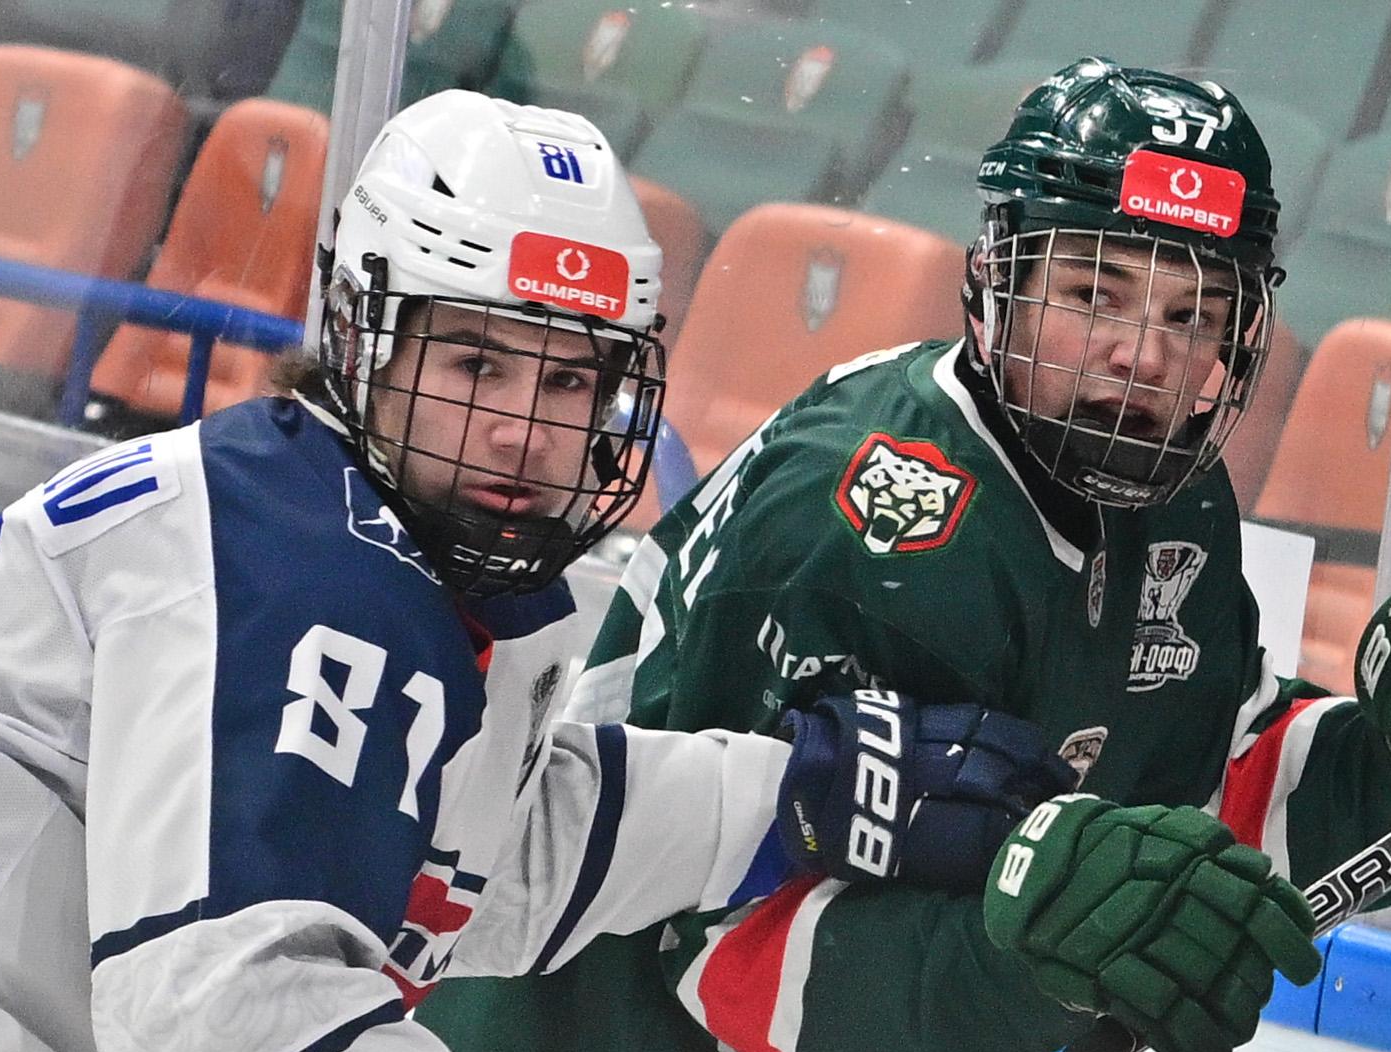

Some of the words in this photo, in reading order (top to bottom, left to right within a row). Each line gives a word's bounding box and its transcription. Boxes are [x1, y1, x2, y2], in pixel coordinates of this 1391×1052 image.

[1146, 97, 1219, 150] 37
[537, 142, 584, 184] 81
[354, 185, 388, 227] BAUER
[1127, 195, 1233, 231] OLIMPBET
[514, 276, 621, 313] OLIMPBET
[274, 624, 445, 823] 81
